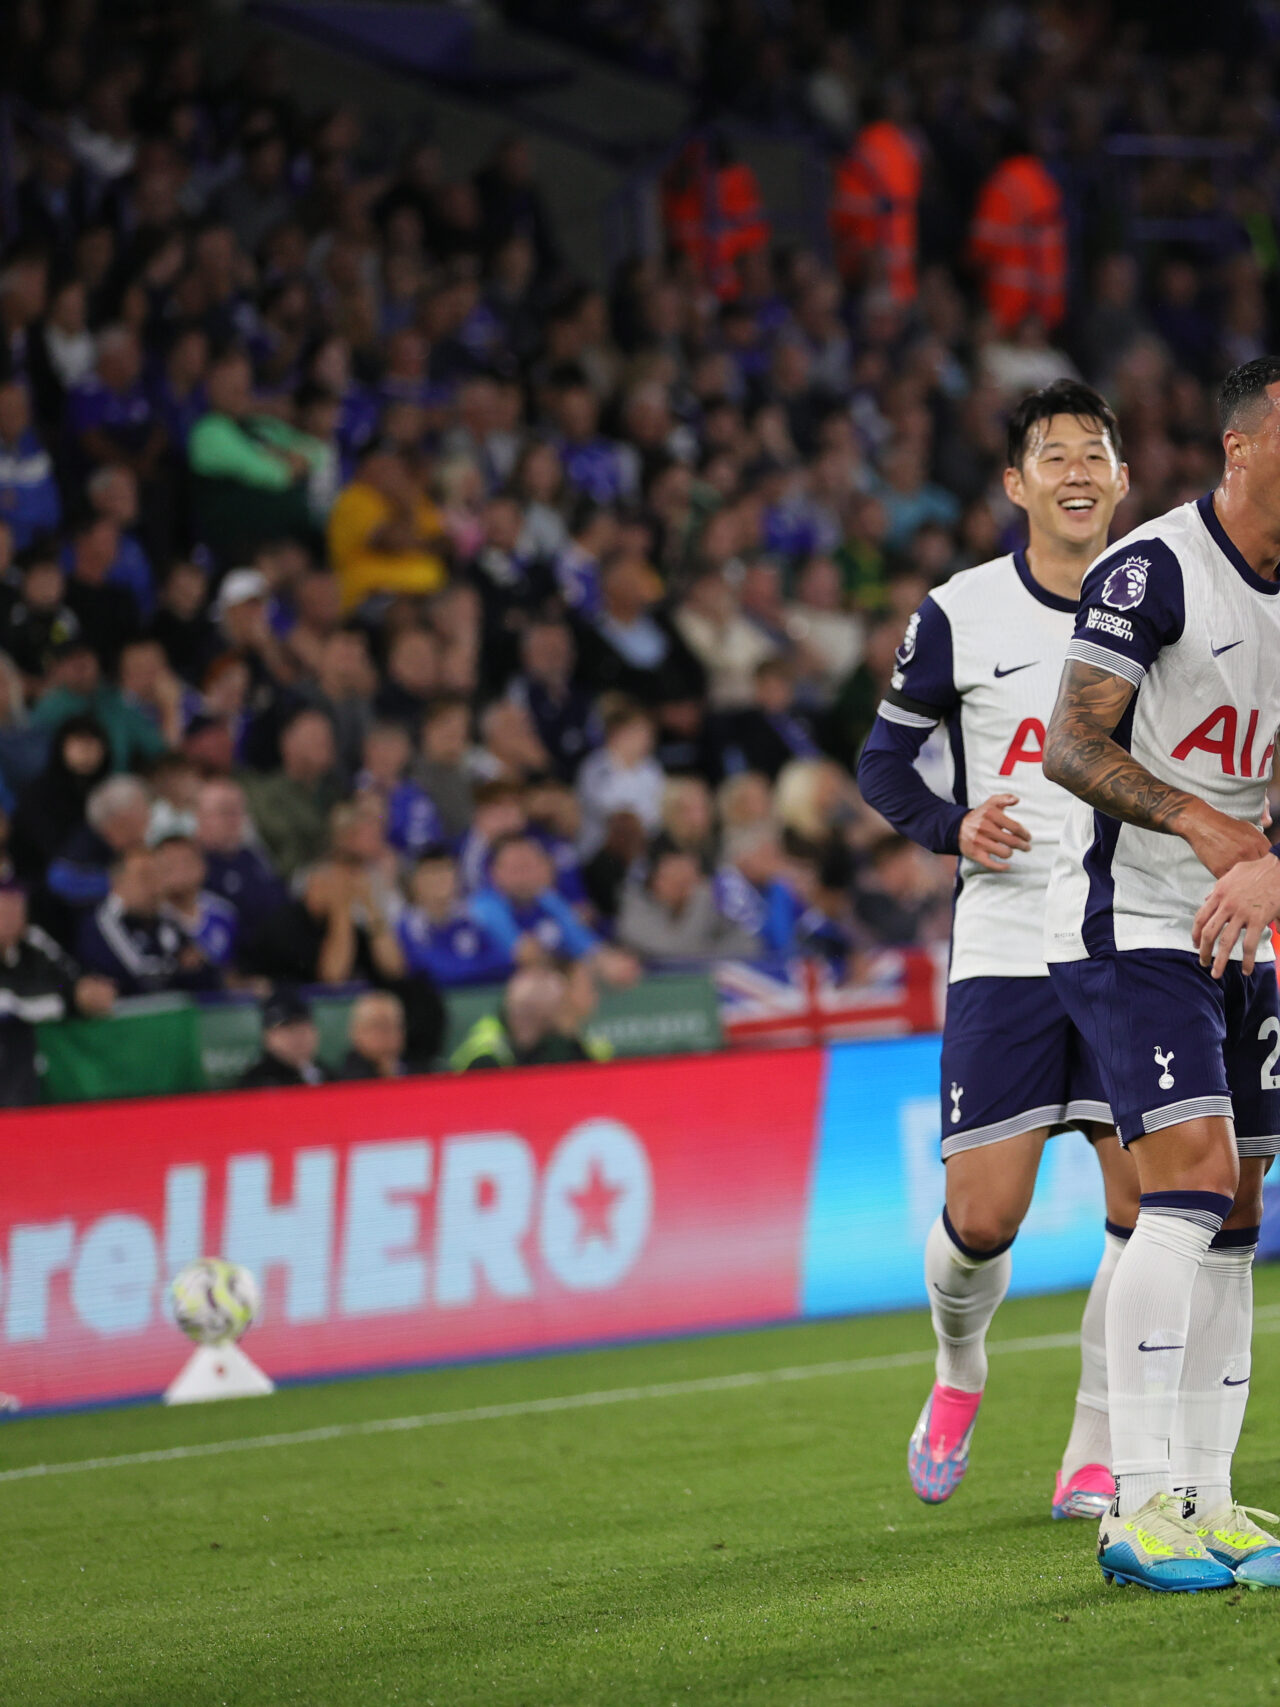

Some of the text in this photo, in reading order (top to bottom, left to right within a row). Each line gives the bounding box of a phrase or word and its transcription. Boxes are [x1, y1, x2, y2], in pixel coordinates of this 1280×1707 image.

[1088, 607, 1132, 631] No room
[1096, 621, 1134, 642] racism
